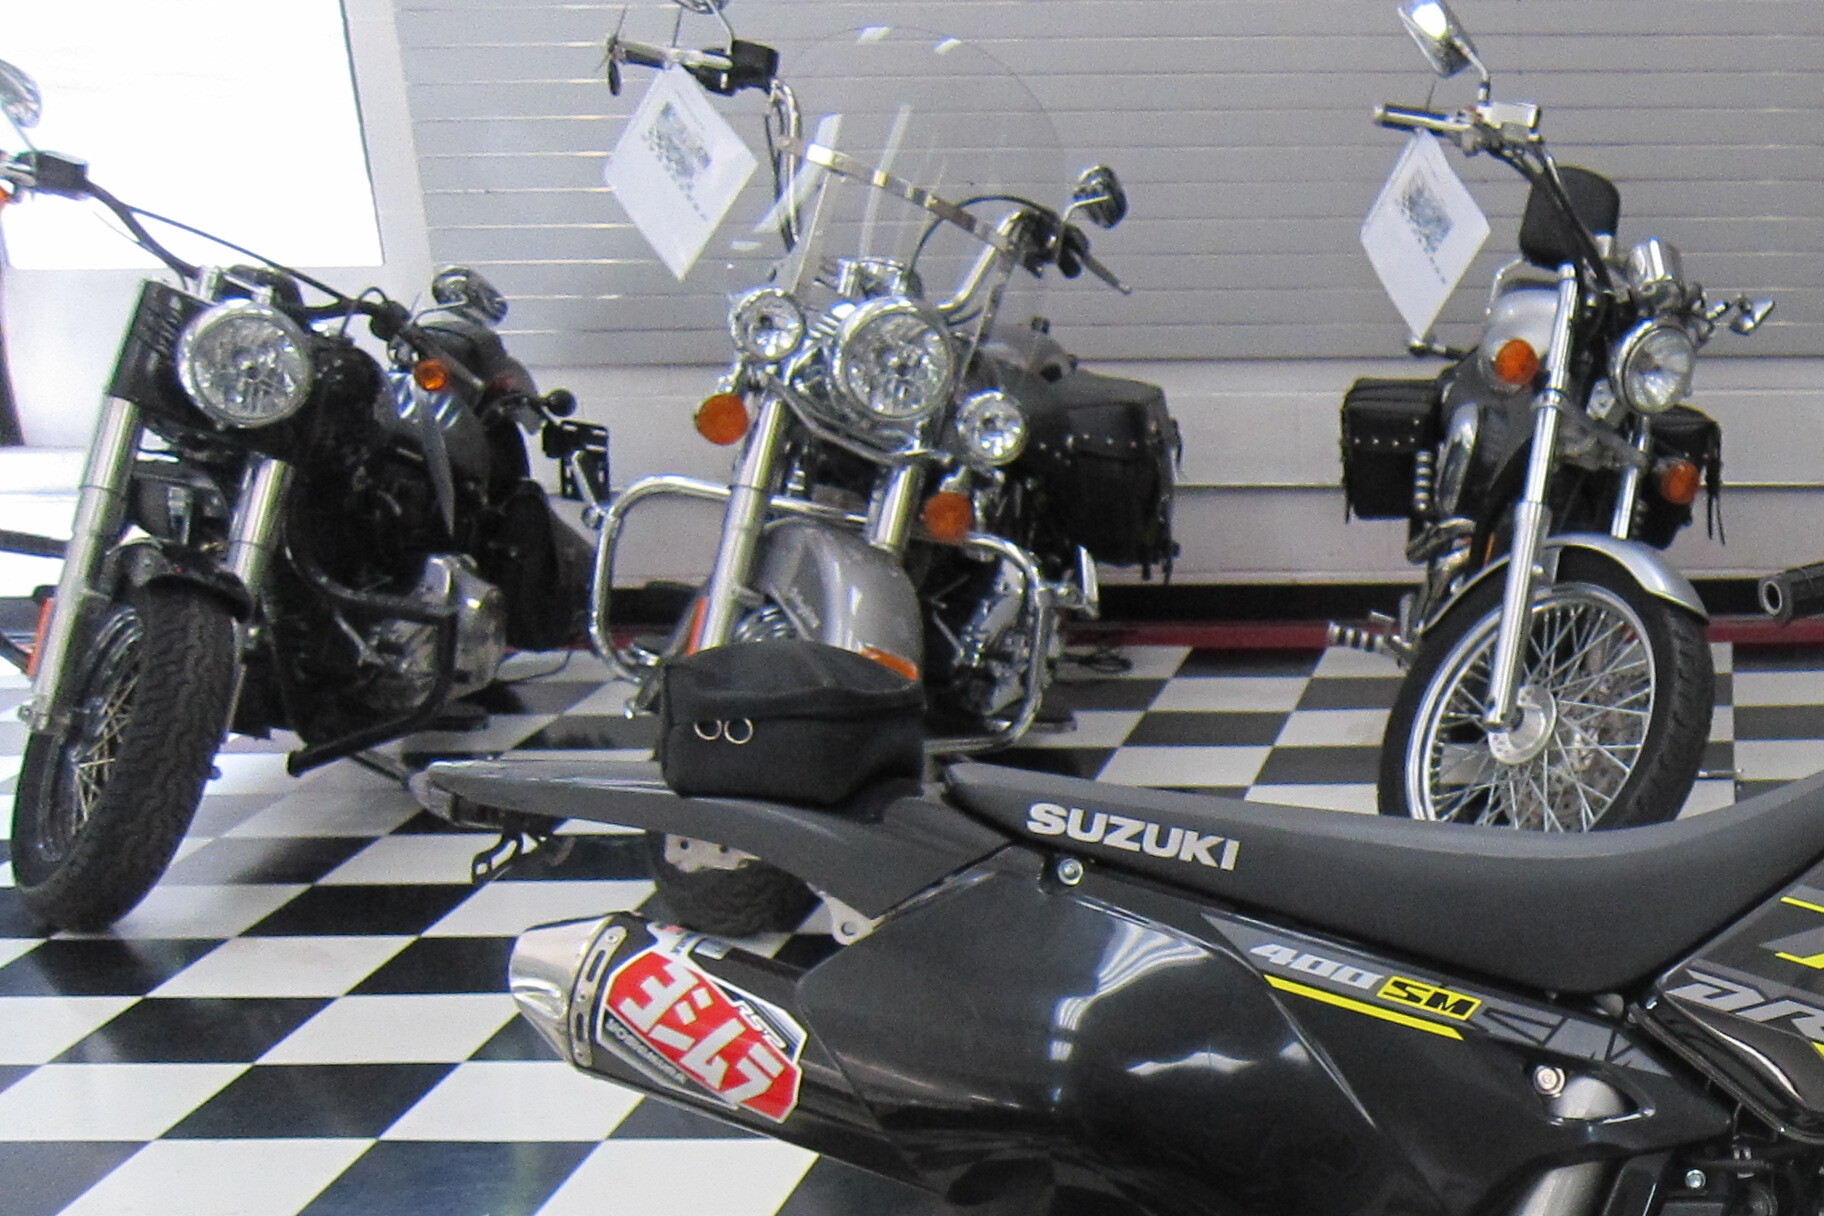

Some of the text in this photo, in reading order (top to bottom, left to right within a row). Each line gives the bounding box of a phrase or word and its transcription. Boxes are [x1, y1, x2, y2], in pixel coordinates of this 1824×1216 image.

[1026, 802, 1241, 871] SUZUKI
[1250, 943, 1474, 1018] 400 SM
